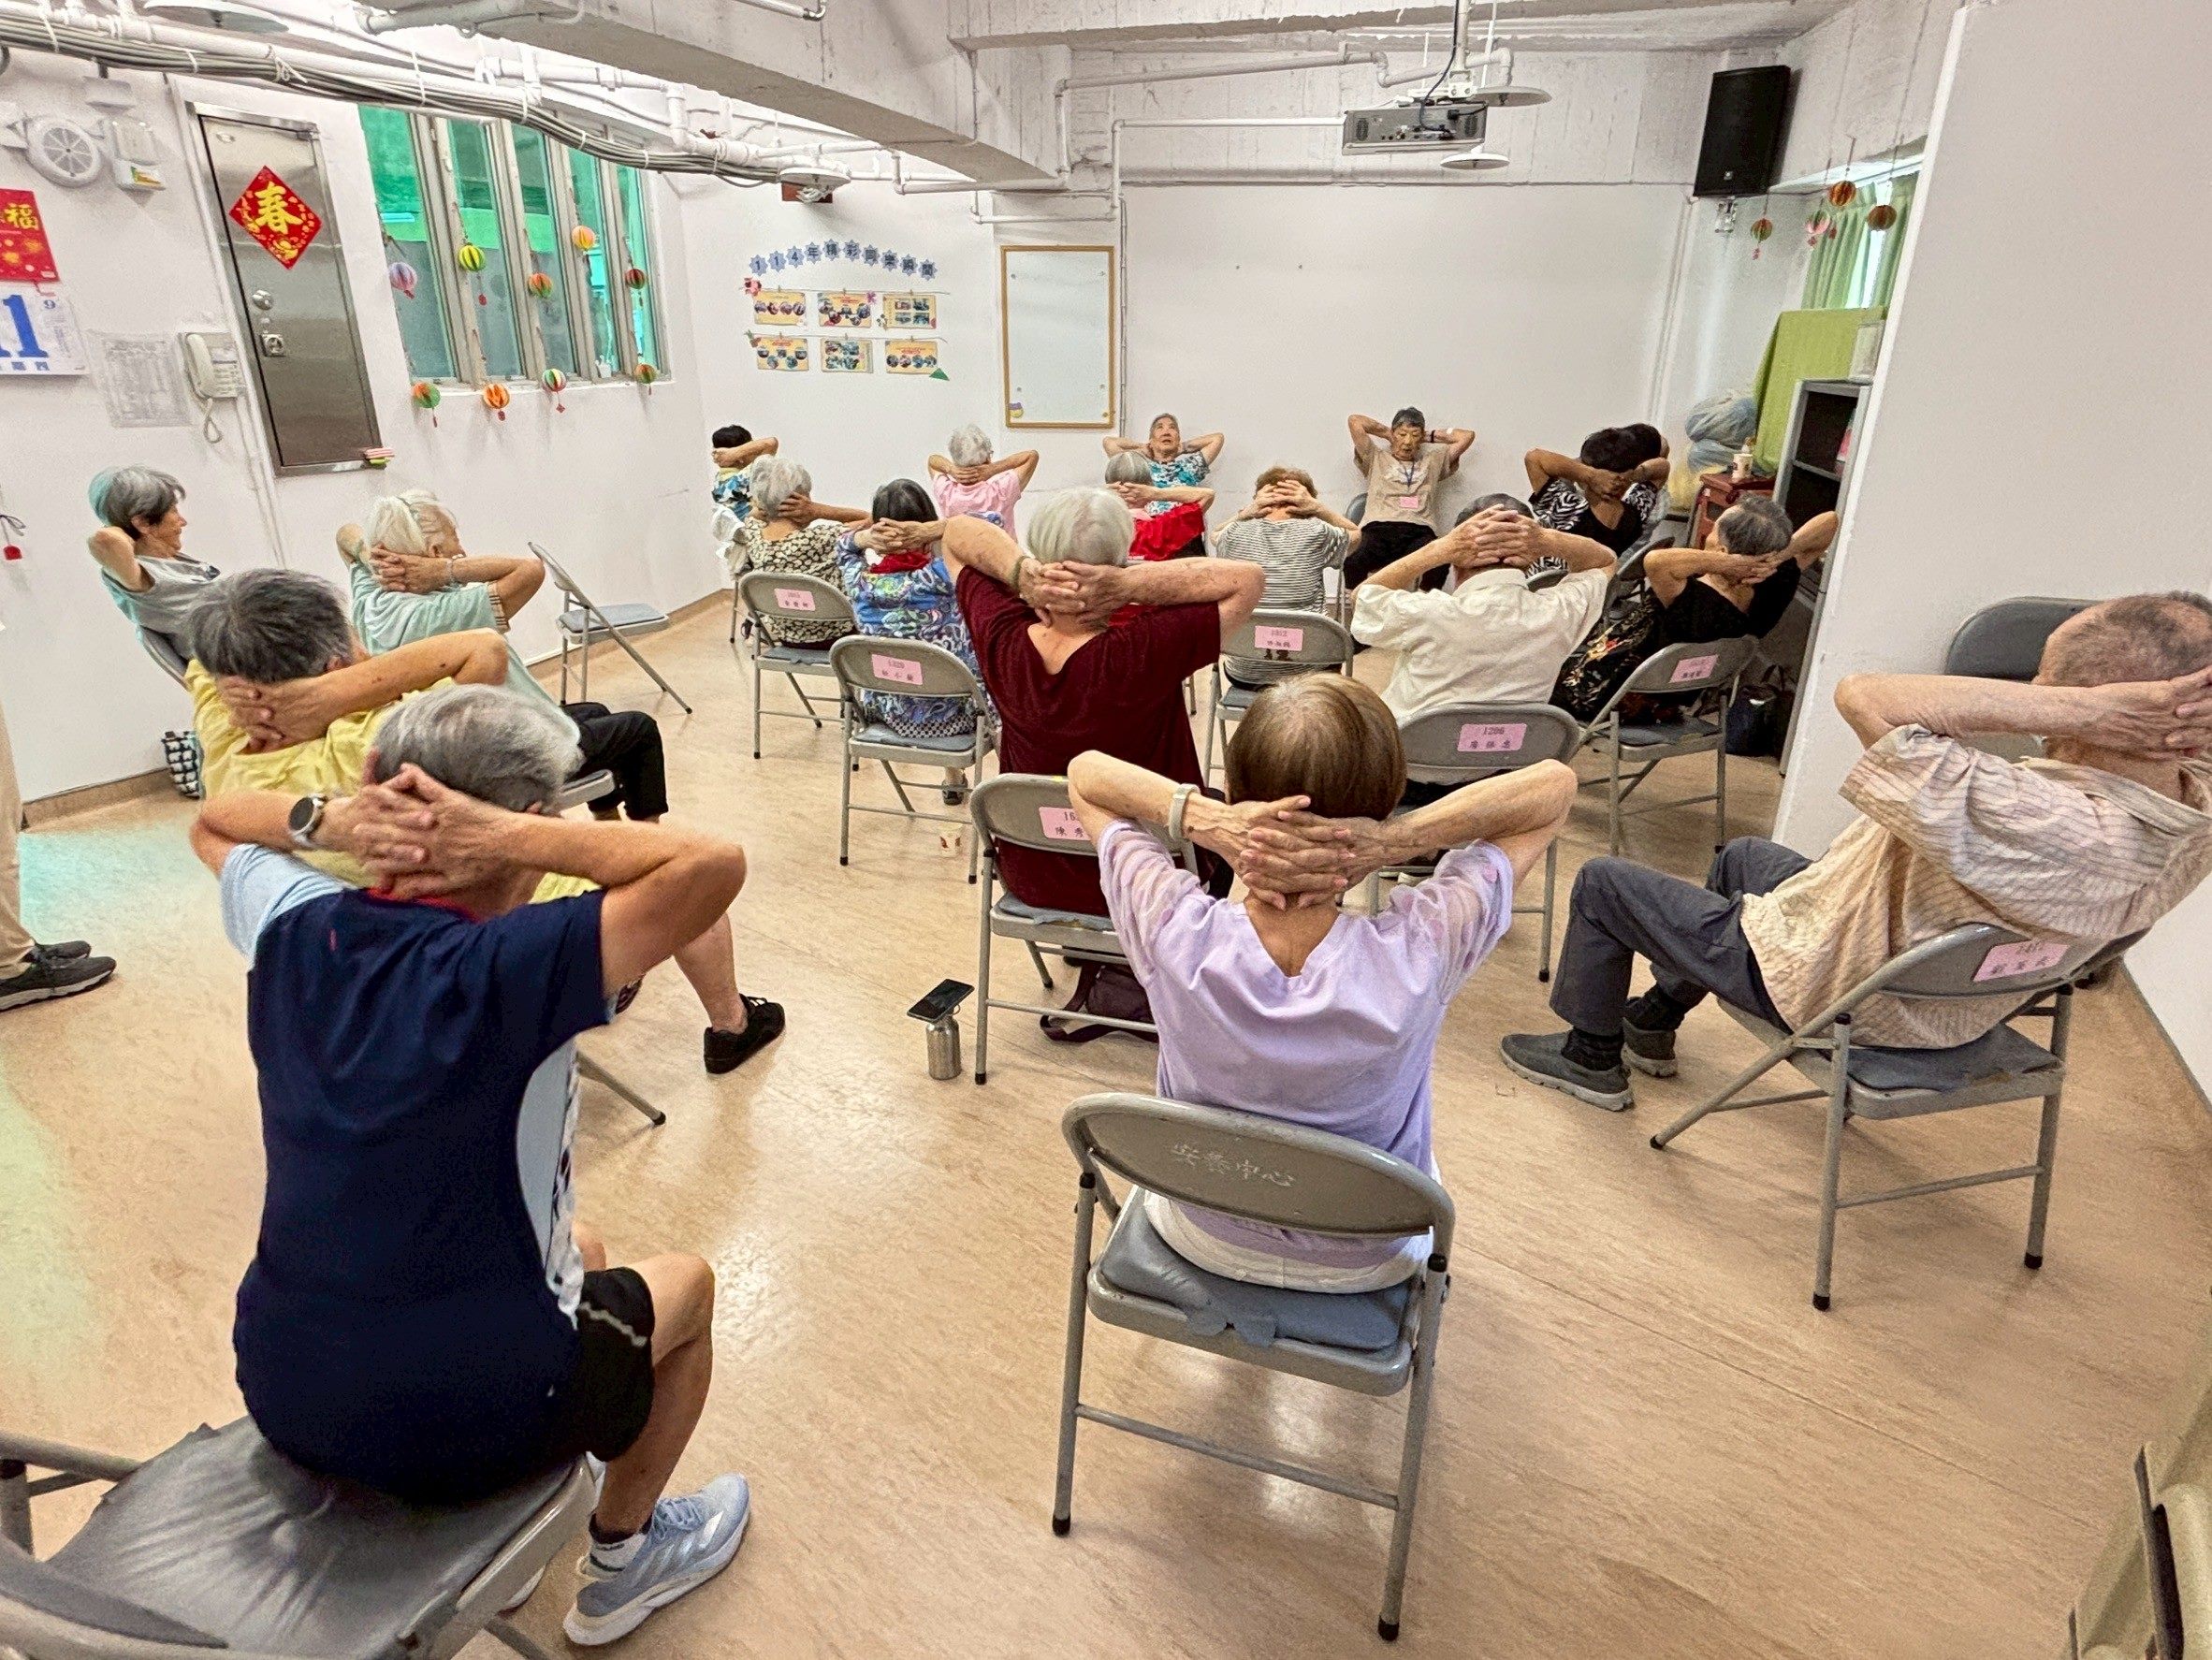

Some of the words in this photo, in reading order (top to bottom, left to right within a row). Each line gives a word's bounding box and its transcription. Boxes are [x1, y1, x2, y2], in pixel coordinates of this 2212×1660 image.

[3, 202, 38, 231] 福
[255, 181, 302, 235] 春
[43, 299, 56, 310] 9
